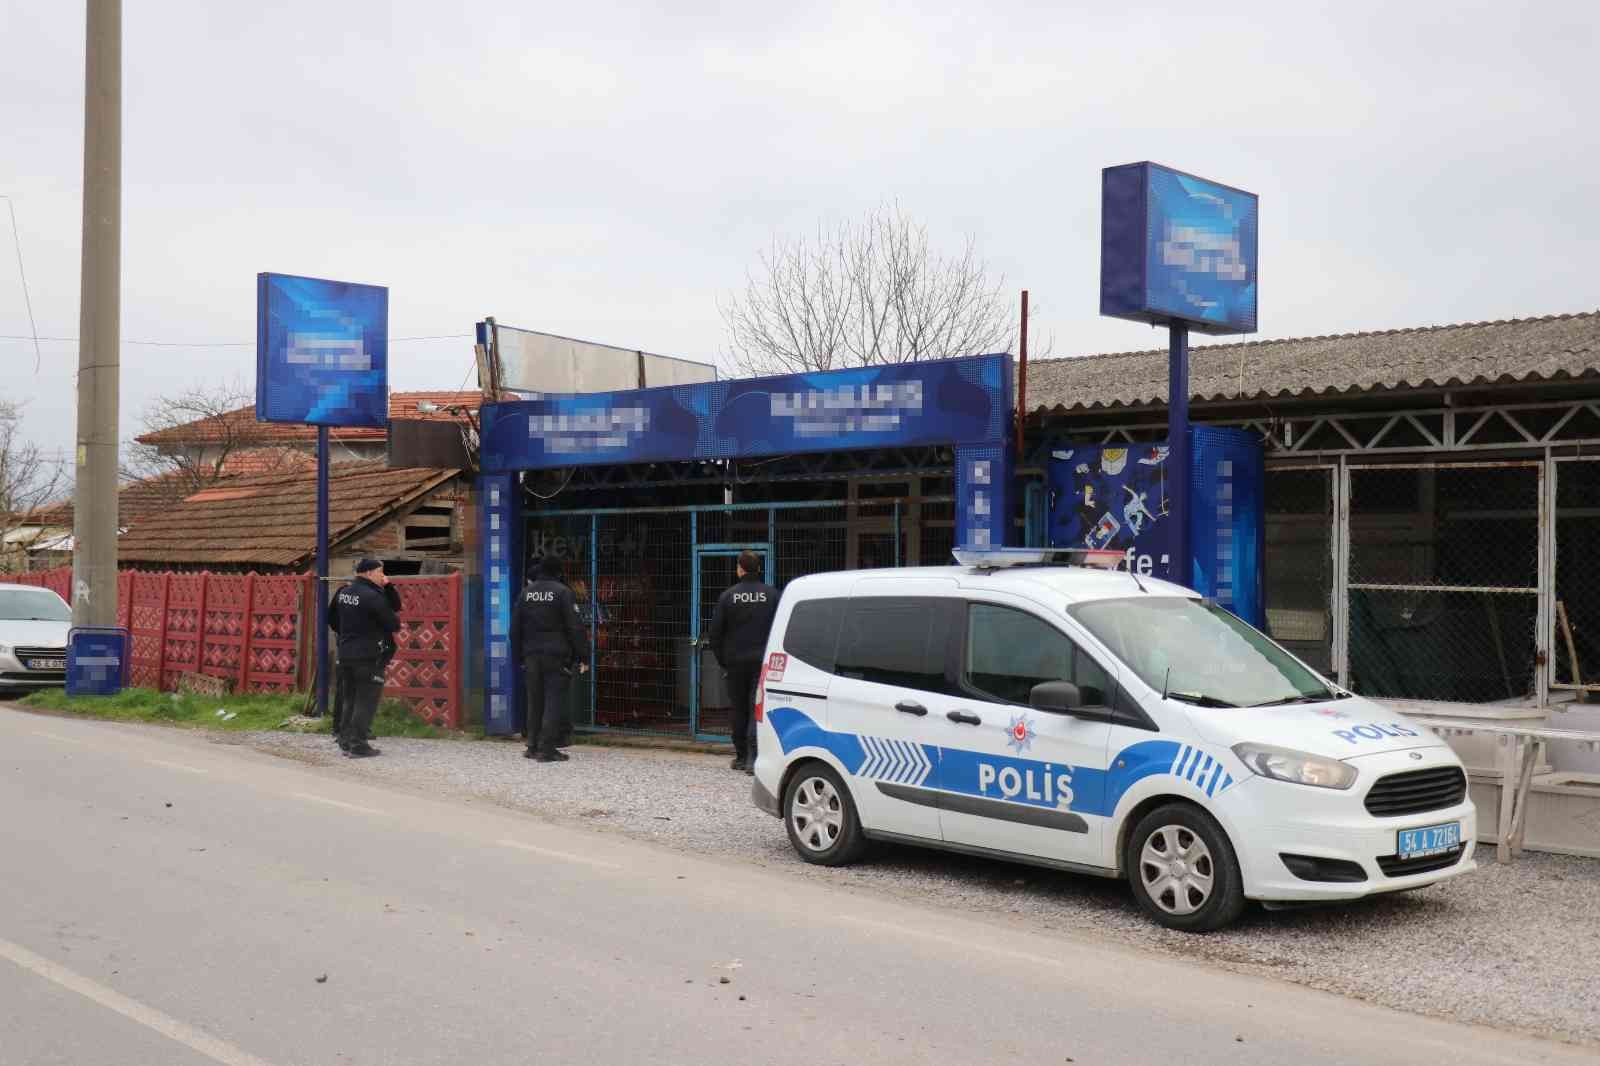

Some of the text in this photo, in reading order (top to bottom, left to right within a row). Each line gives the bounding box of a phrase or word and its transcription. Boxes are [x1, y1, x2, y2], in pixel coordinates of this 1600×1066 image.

[526, 591, 554, 602] POLIS
[733, 591, 767, 604] POLIS
[770, 655, 785, 667] 112
[1404, 831, 1417, 851] 54
